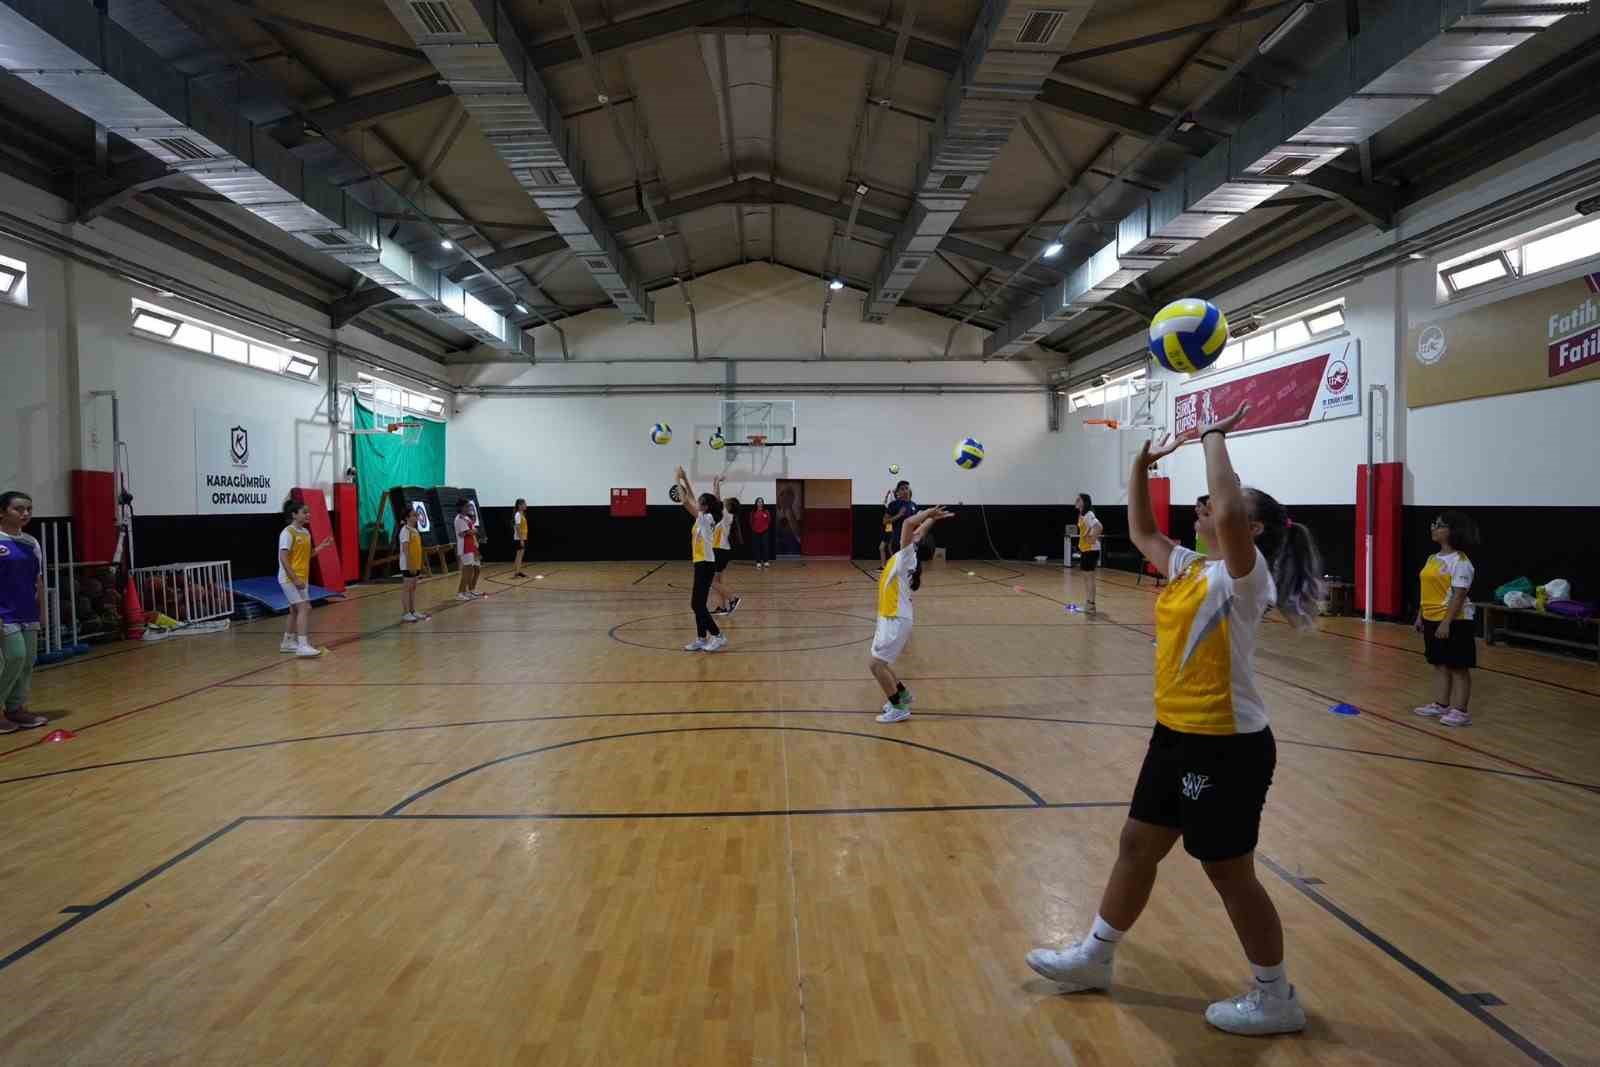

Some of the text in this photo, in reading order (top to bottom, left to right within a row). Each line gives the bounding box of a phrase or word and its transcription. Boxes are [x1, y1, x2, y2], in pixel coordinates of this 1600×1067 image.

[1548, 299, 1598, 338] Fatih
[206, 473, 271, 488] KARAGÜMRÜK
[212, 492, 267, 504] ORTAOKULU
